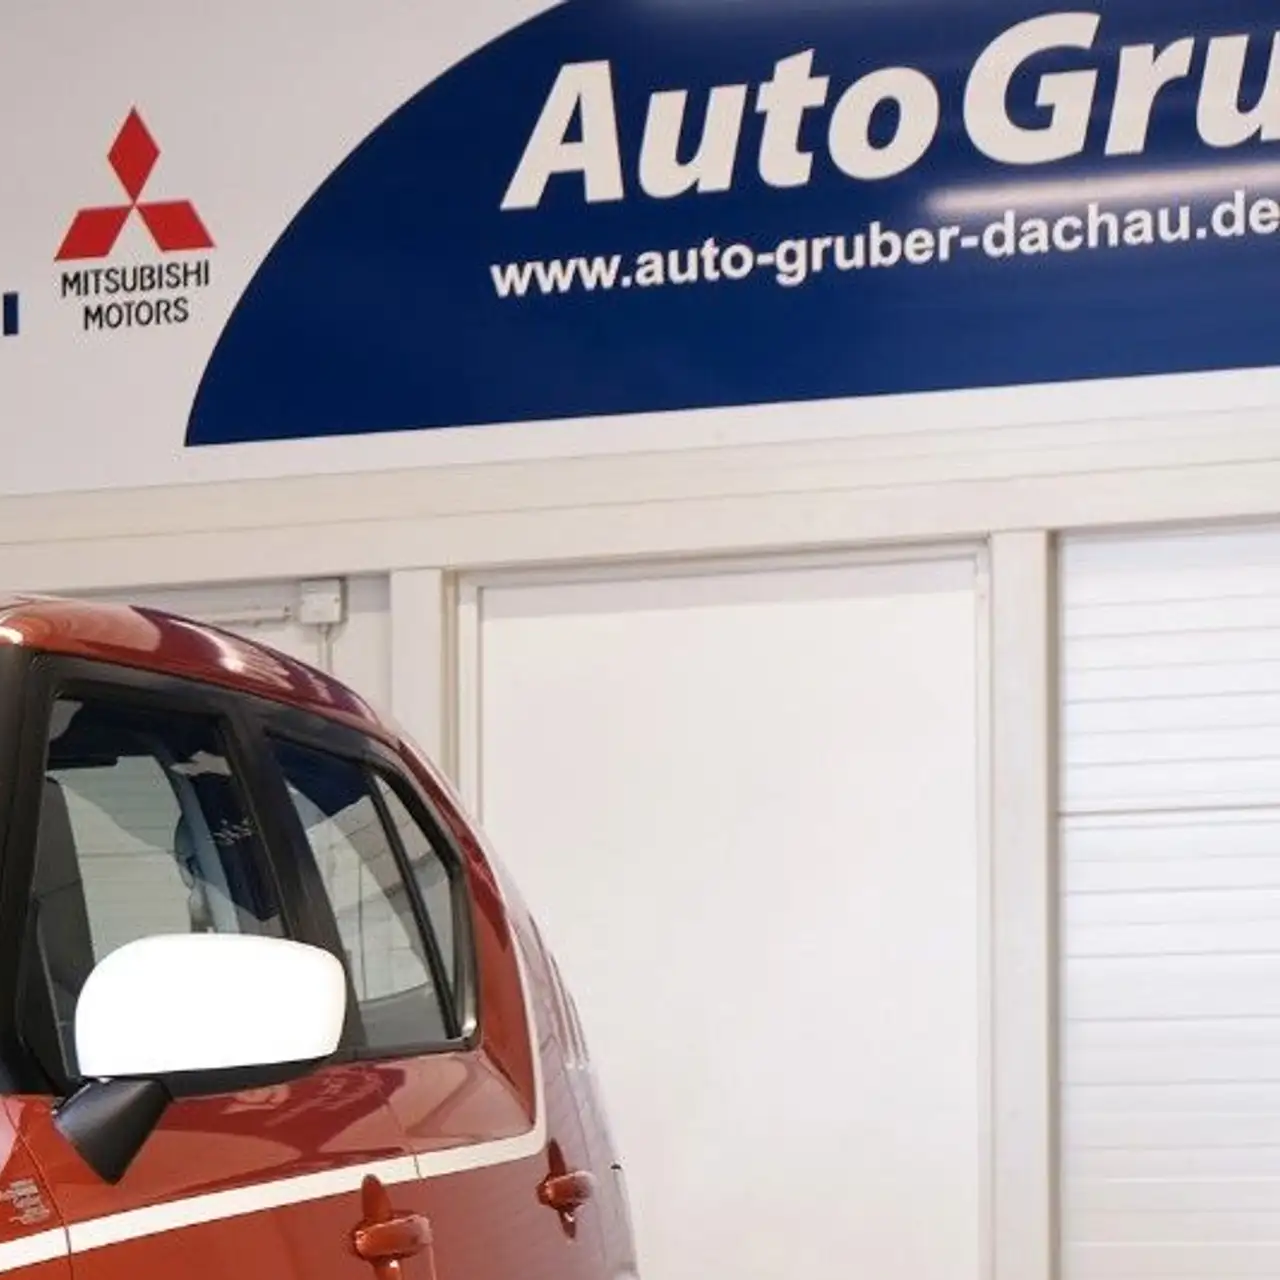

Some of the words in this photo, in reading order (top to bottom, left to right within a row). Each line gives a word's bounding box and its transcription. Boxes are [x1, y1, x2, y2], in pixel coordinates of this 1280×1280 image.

[490, 190, 1280, 298] www.auto-gruber-dachau.de
[60, 259, 211, 298] MITSUBISHI
[82, 296, 190, 331] MOTORS
